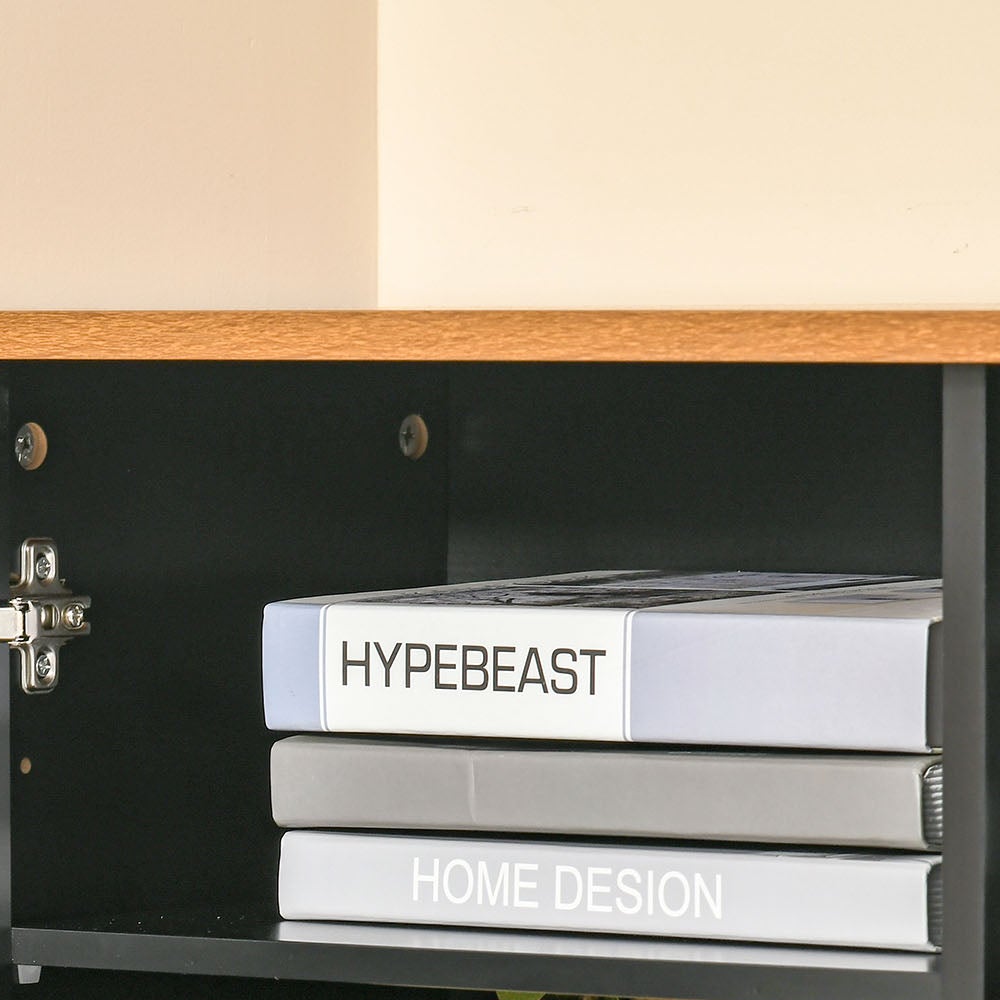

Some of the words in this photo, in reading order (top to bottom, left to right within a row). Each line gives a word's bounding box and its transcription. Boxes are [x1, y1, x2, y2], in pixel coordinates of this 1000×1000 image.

[342, 641, 606, 695] HYPEBEAST
[412, 857, 539, 908] HOME
[554, 865, 722, 919] DESION
